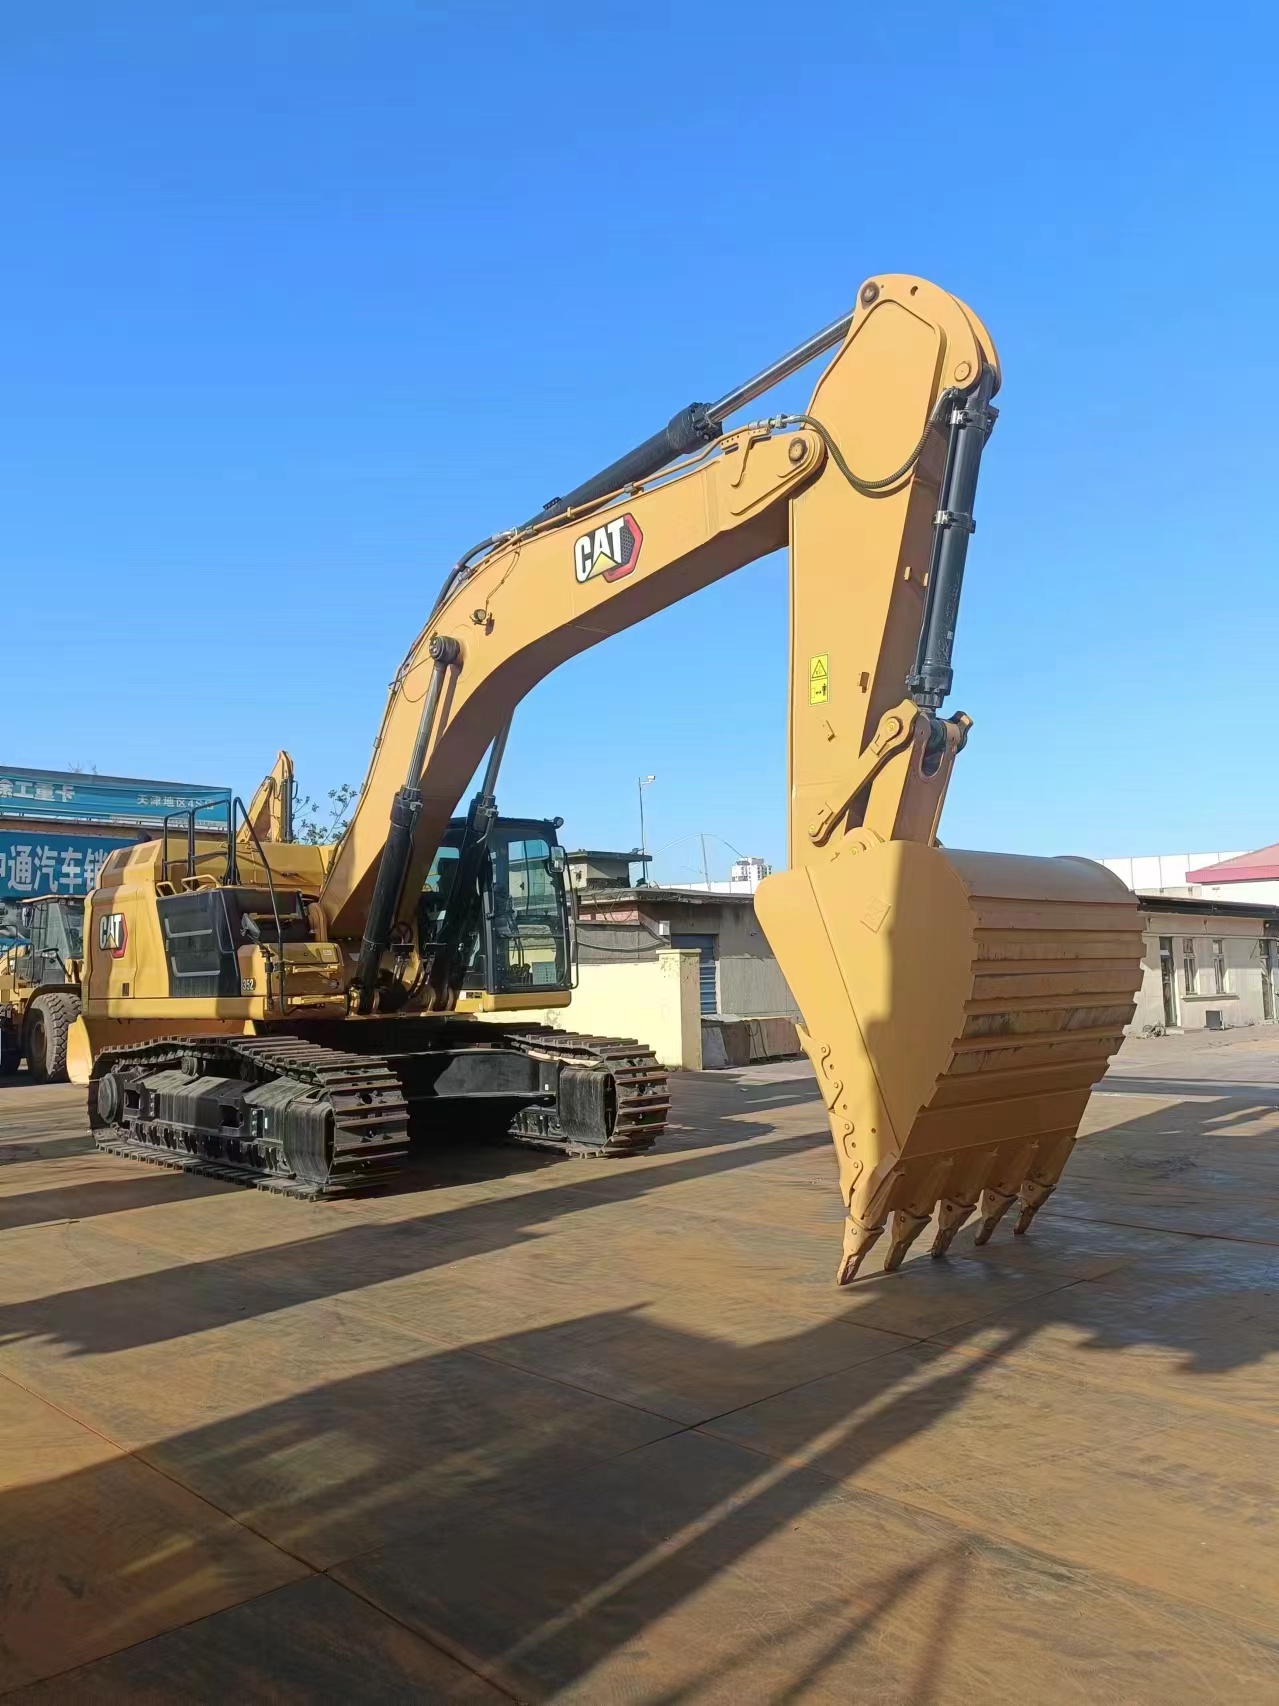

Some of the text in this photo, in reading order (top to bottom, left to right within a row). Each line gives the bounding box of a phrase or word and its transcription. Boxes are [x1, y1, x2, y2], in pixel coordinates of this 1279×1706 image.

[574, 516, 625, 582] CAT
[100, 914, 122, 949] CAT
[242, 978, 254, 991] 352
